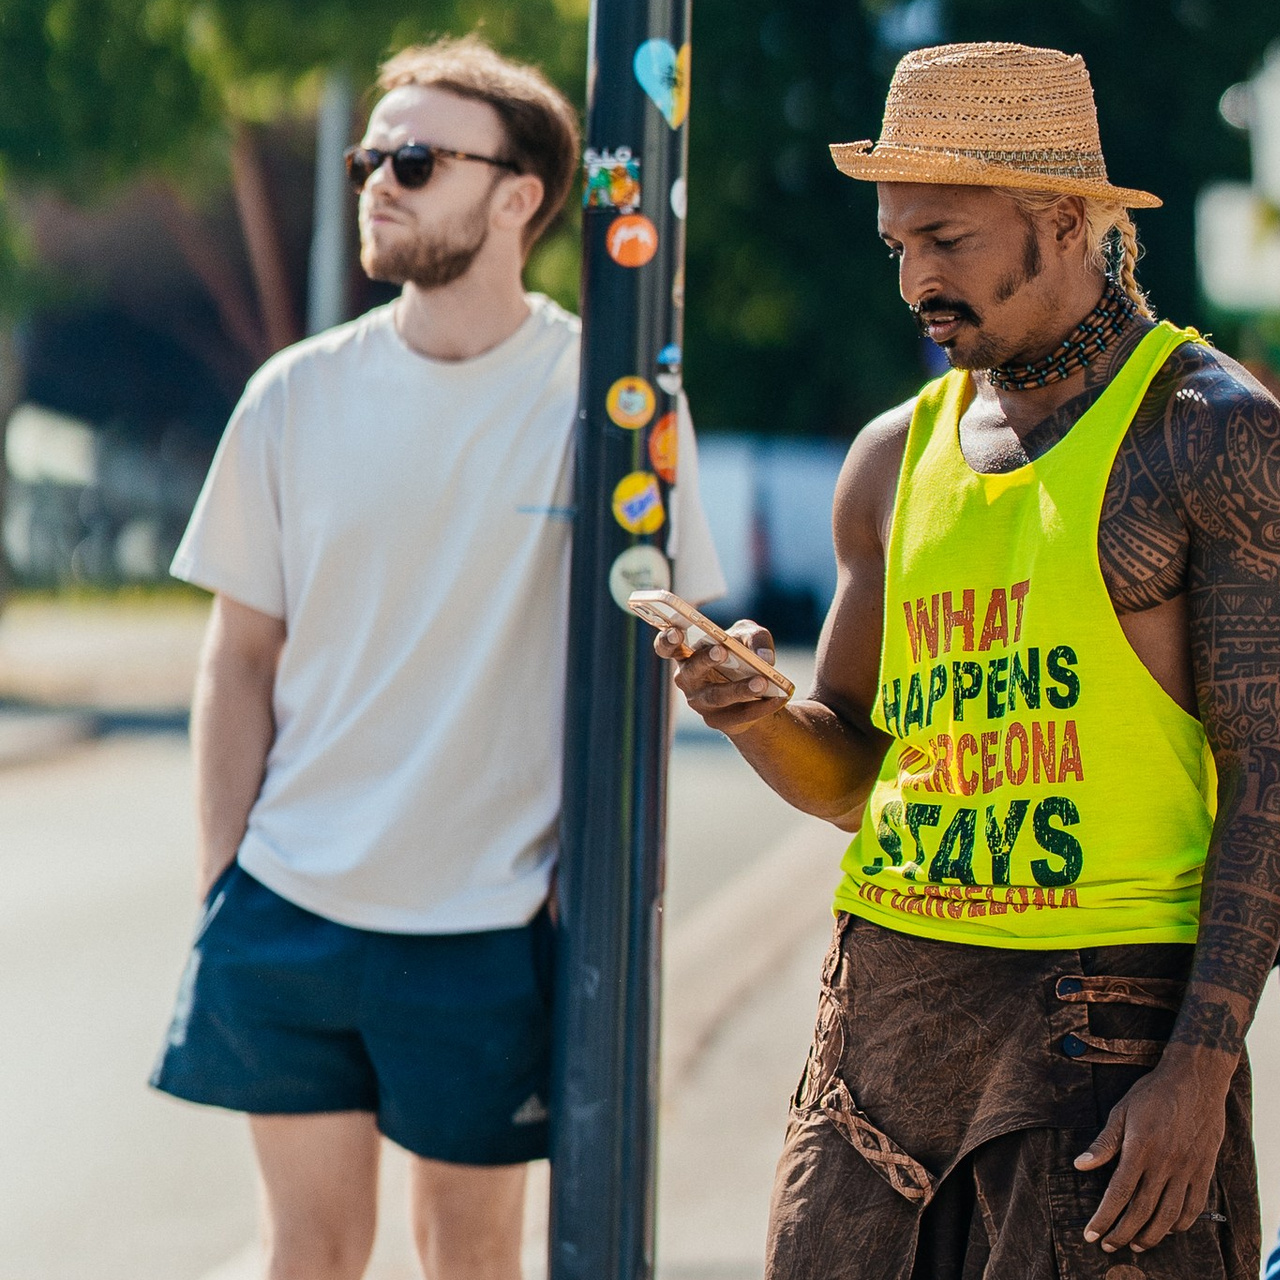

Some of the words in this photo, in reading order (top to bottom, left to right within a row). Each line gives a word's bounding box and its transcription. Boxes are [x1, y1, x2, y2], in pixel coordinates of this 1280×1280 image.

[903, 579, 1031, 664] WHAT
[882, 645, 1081, 740] HAPPENS
[897, 720, 1084, 797] ARCEONA
[862, 796, 1083, 887] STAYS
